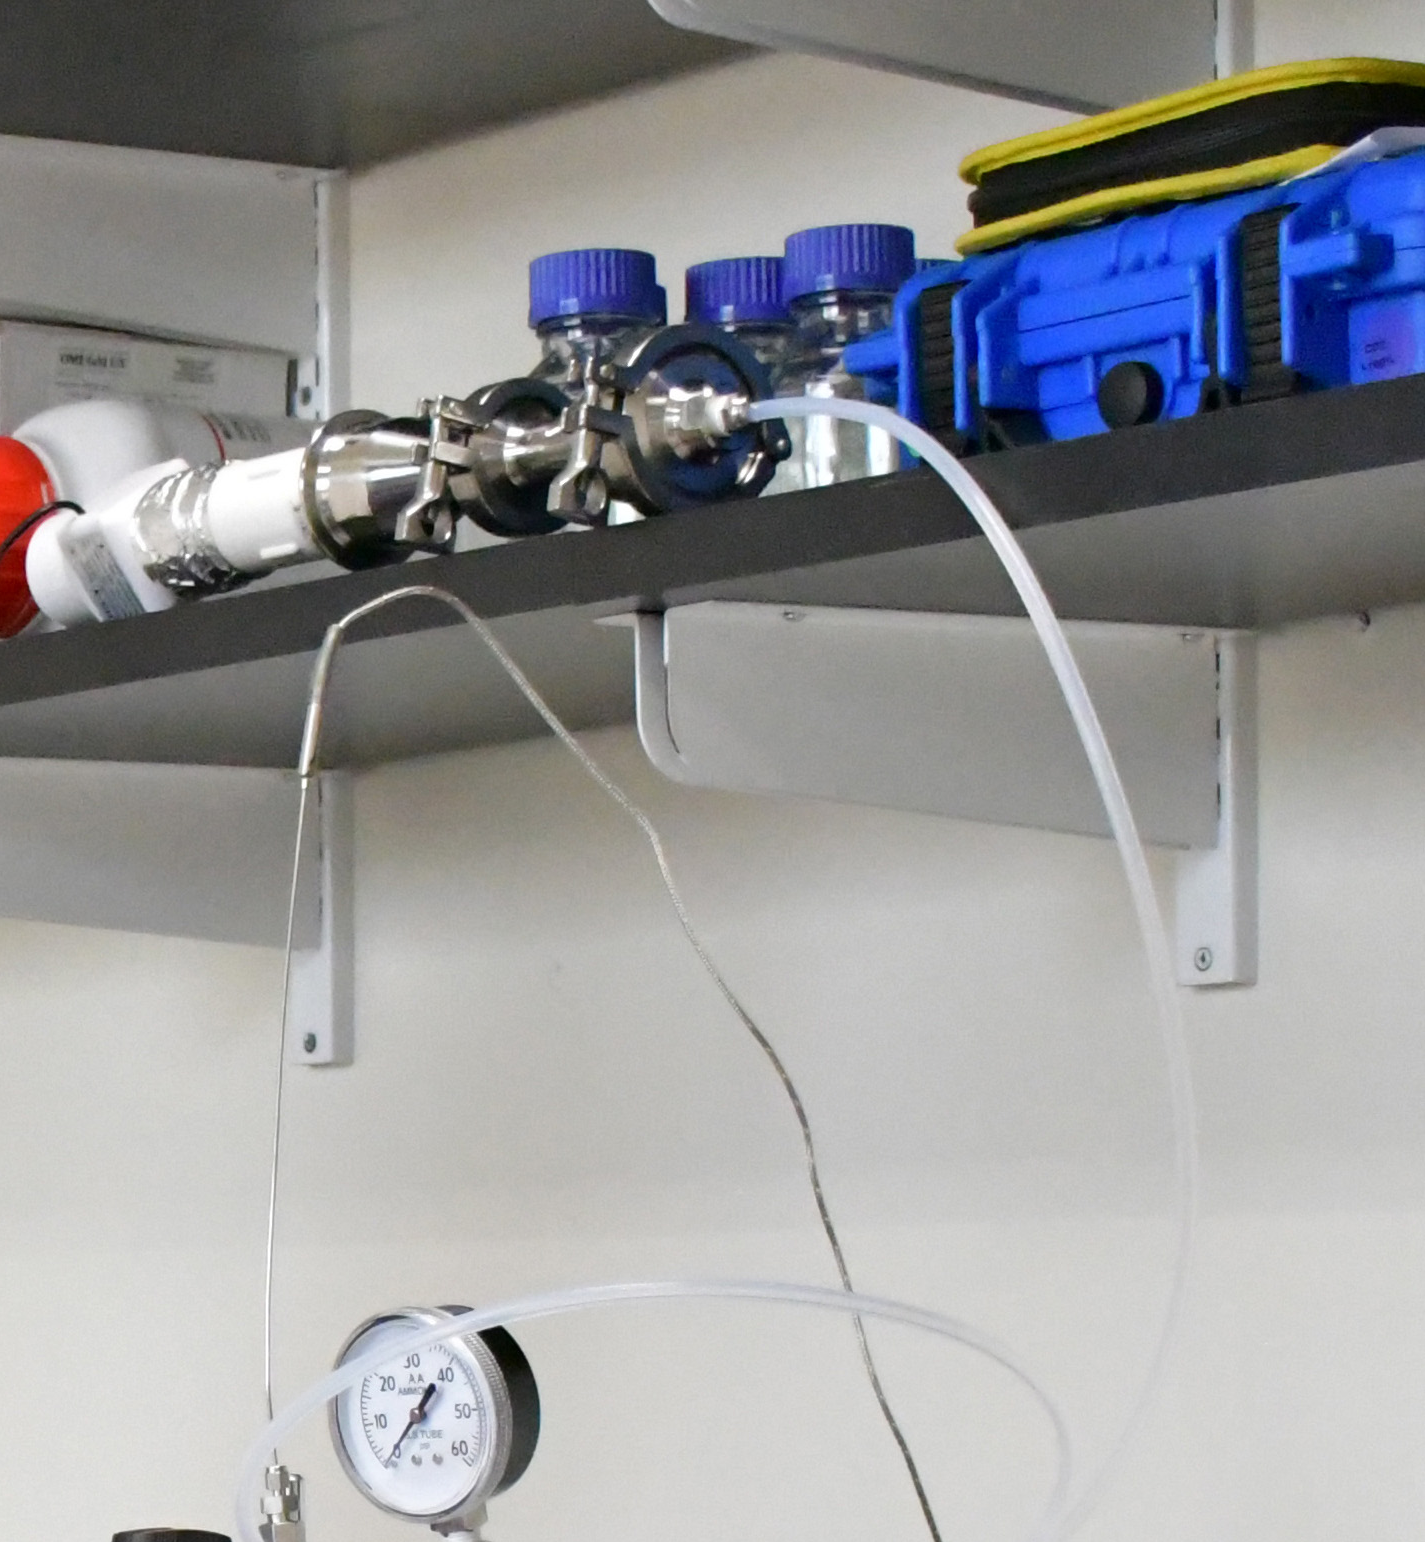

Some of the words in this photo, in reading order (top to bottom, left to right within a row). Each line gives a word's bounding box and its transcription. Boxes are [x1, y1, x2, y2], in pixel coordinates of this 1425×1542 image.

[408, 1373, 425, 1384] AA
[437, 1366, 454, 1383] 40
[379, 1375, 396, 1392] 20
[454, 1402, 471, 1419] 50
[374, 1413, 388, 1429] 10
[451, 1440, 468, 1457] 60
